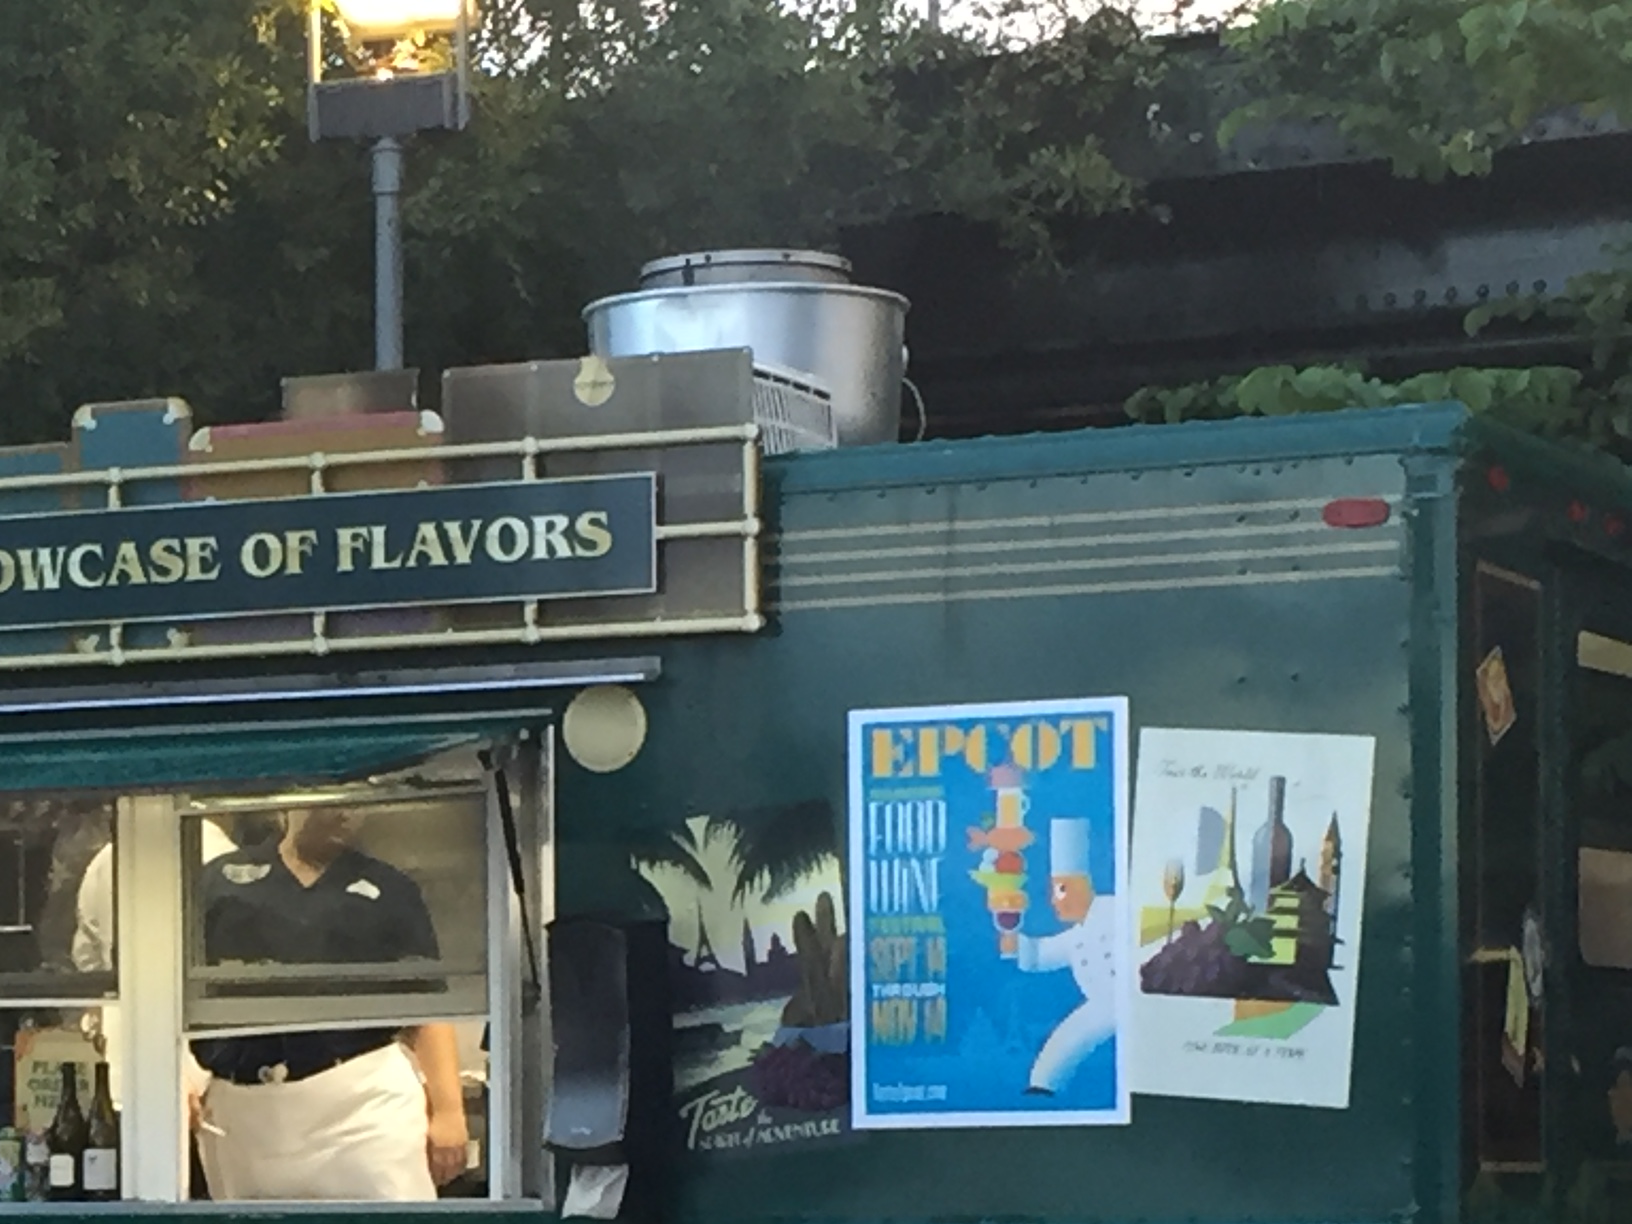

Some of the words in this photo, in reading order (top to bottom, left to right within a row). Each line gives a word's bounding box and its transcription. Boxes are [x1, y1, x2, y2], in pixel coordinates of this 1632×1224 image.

[240, 528, 319, 579] OF
[335, 510, 614, 574] FLAVORS
[871, 717, 1109, 778] EPCOT
[869, 799, 948, 855] FOOD
[679, 1085, 759, 1150] Taste
